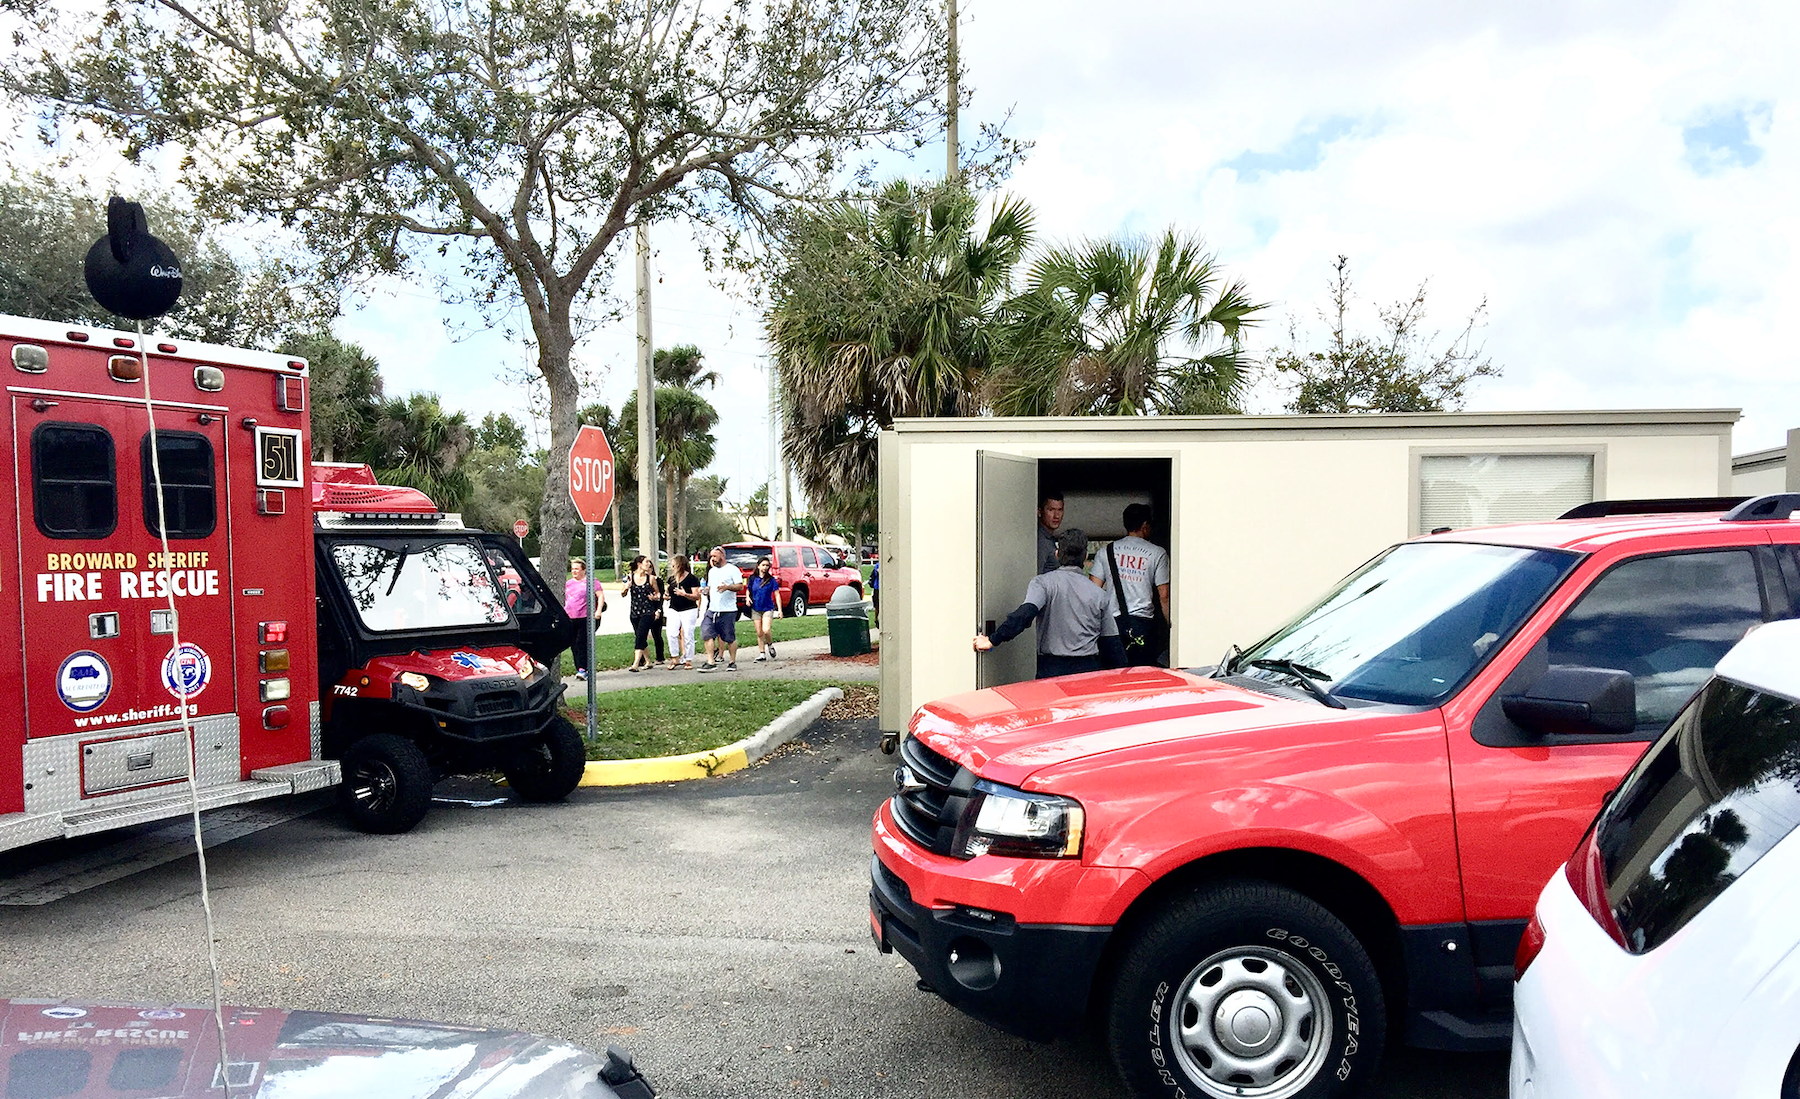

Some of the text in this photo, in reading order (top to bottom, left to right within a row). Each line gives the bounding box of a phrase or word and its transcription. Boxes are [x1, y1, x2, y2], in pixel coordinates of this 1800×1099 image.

[264, 435, 294, 480] 51
[573, 456, 612, 493] STOP
[47, 551, 209, 571] BROWARD SHERIFF
[37, 570, 219, 603] FIRE RESCUE
[334, 685, 358, 697] 7742
[74, 704, 198, 727] www.sheriff.org
[1266, 927, 1360, 1081] GOODYEAR
